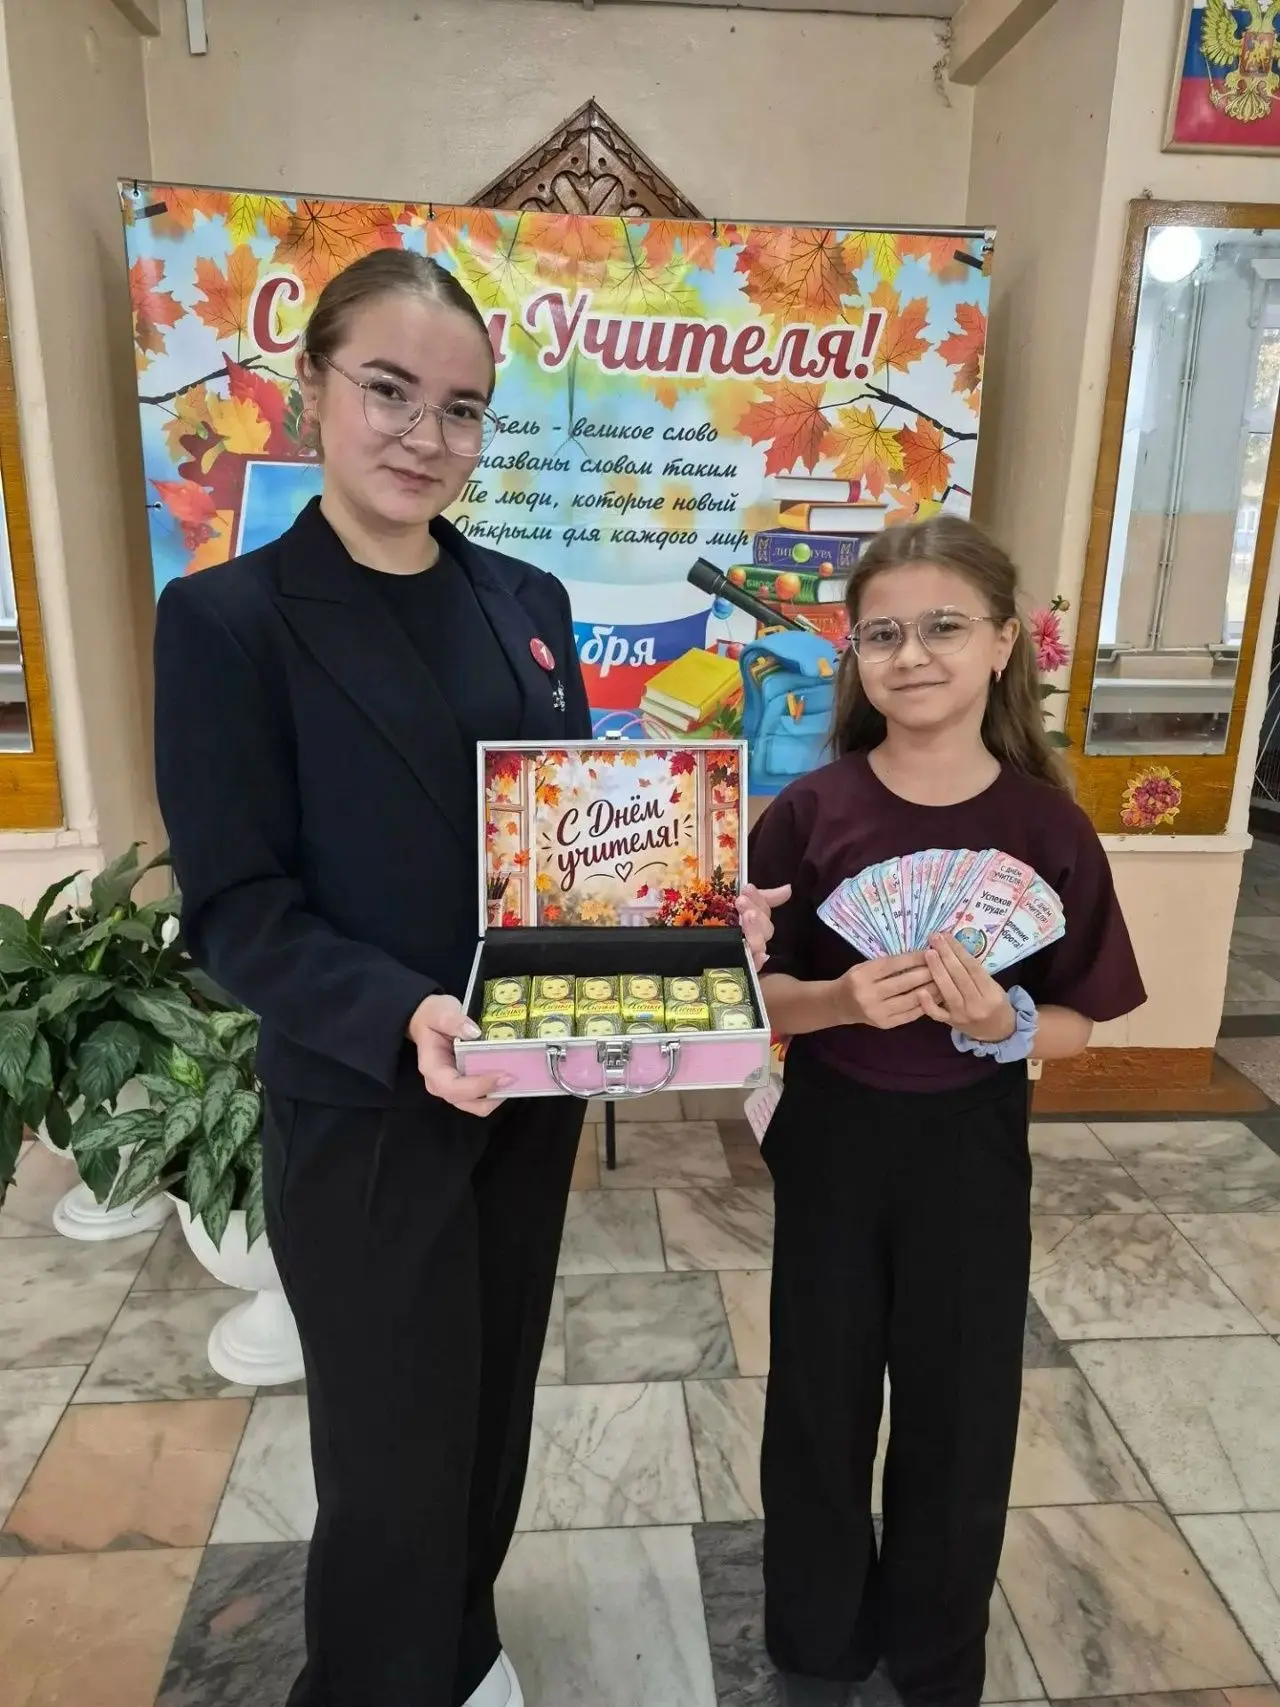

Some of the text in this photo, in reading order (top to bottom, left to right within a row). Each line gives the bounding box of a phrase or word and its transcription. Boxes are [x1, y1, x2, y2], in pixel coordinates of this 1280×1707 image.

[253, 277, 300, 354] С
[526, 291, 883, 380] Учителя!
[571, 416, 655, 441] великое
[662, 422, 718, 442] слово
[477, 451, 738, 478] названы словом таким
[495, 489, 559, 512] люди,
[571, 490, 665, 515] которые
[672, 493, 739, 512] новый
[454, 515, 748, 552] Открыли для каждого мир
[577, 625, 657, 678] бря
[556, 794, 665, 847] С Днём
[557, 818, 680, 892] учителя!
[981, 890, 1012, 907] Успехов
[982, 902, 1008, 916] труде!
